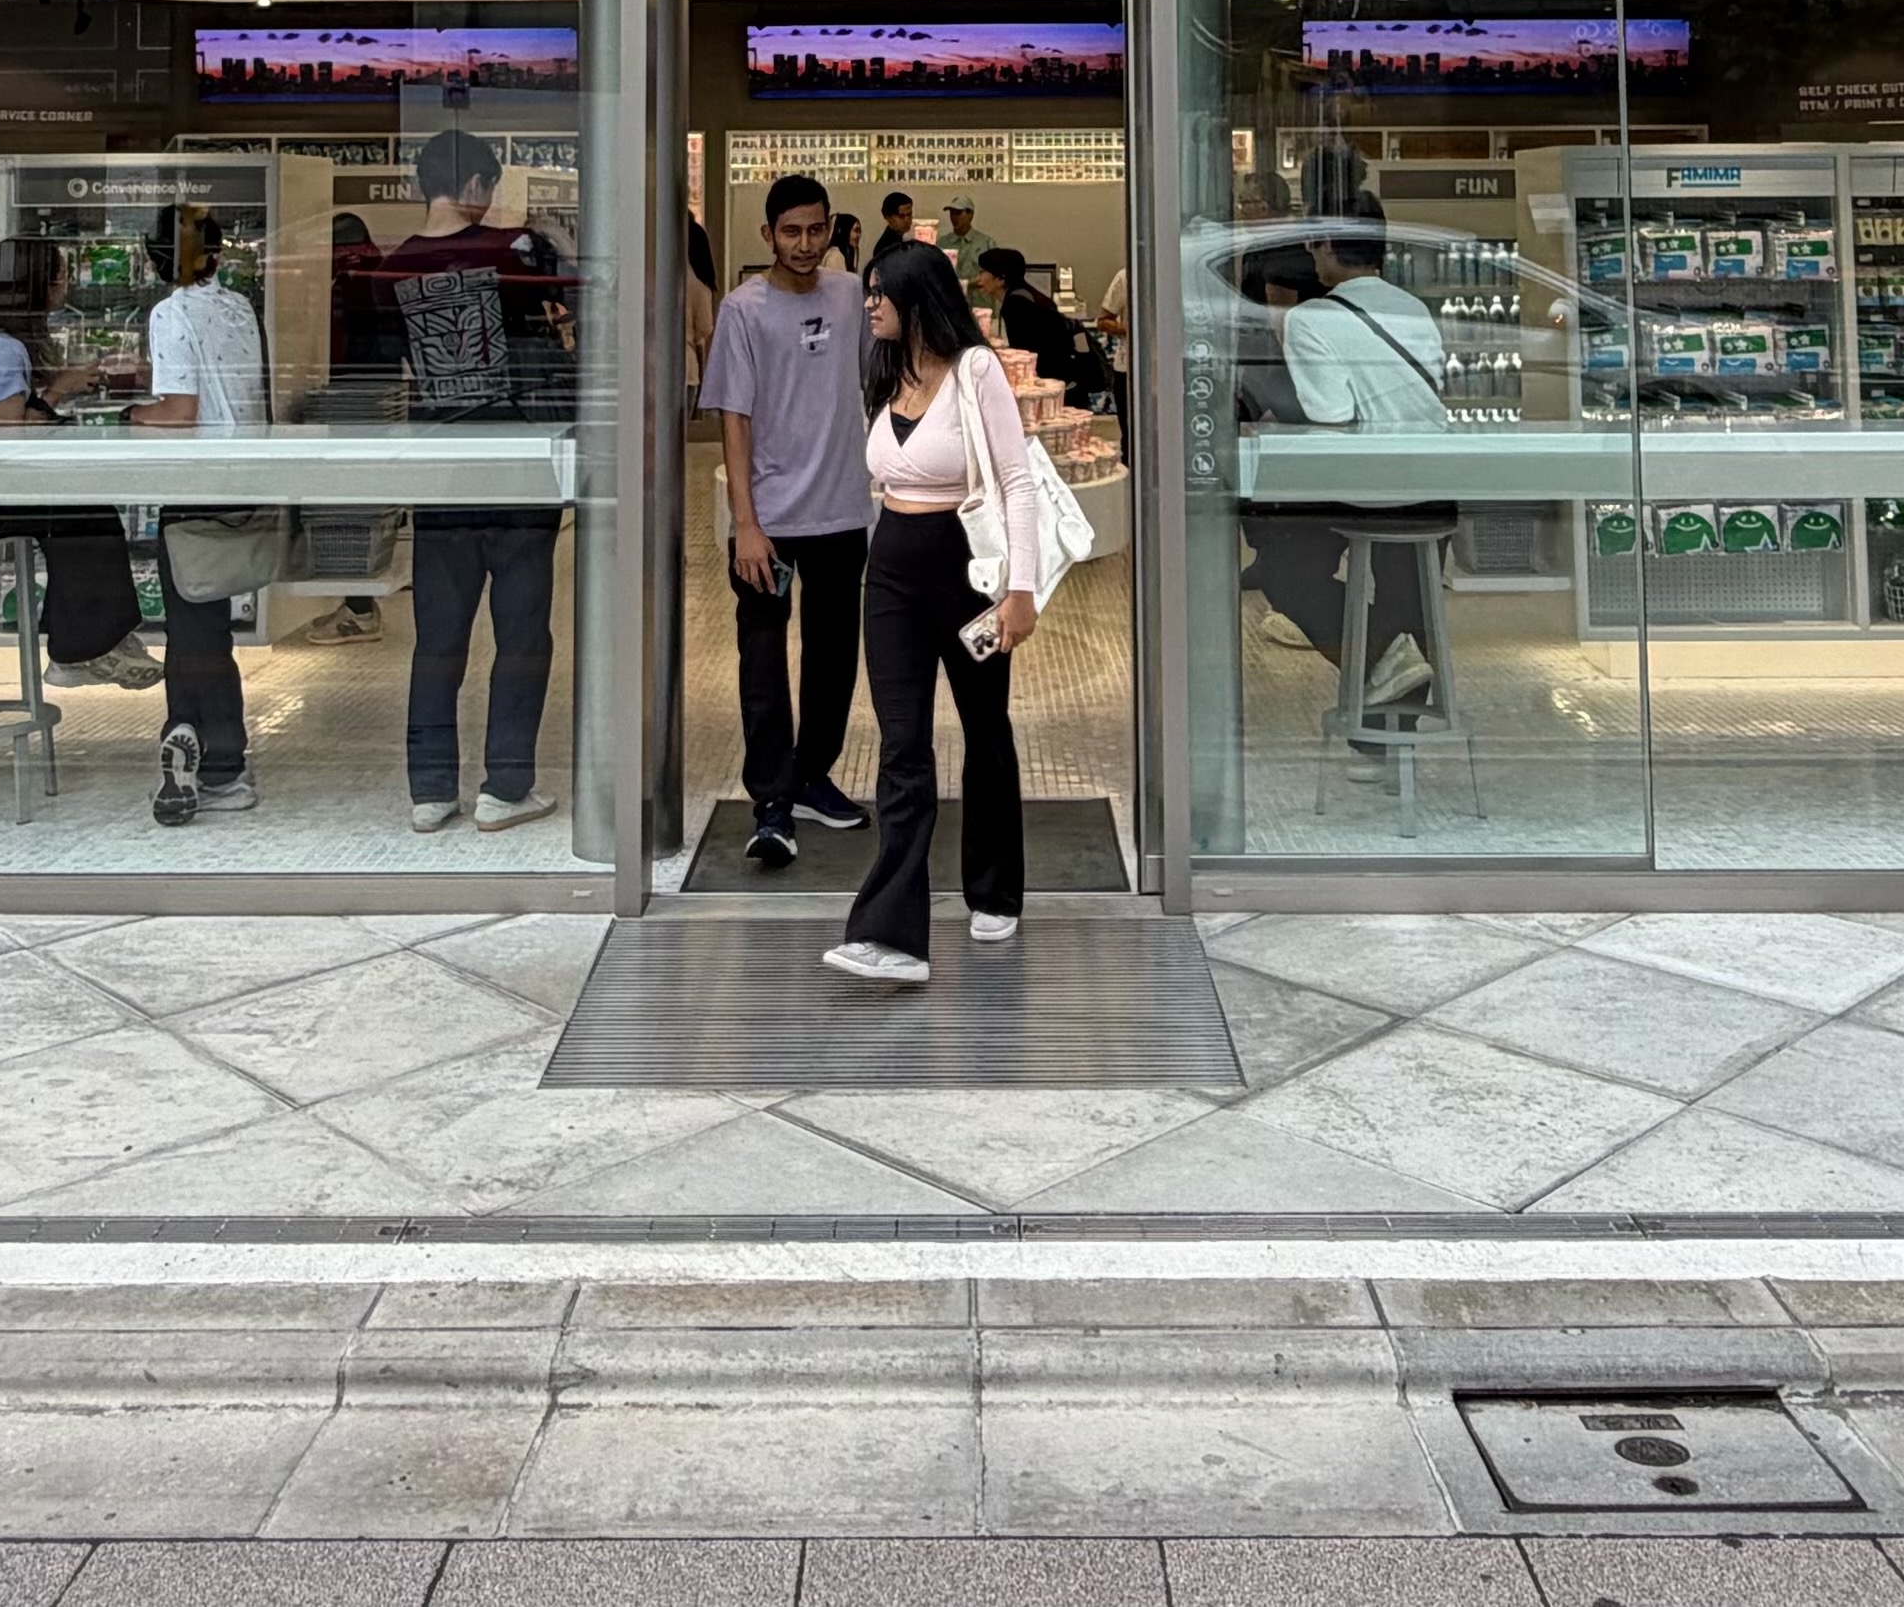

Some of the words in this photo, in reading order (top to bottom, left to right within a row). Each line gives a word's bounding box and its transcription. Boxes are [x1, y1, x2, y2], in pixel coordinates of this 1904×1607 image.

[1798, 85, 1832, 97] SELF
[1836, 83, 1878, 96] CHECK
[39, 111, 94, 122] CORNER
[1665, 167, 1741, 188] FAMIMA
[91, 181, 177, 195] Convenience
[178, 181, 213, 195] Wear
[369, 183, 412, 201] FUN
[1455, 177, 1498, 195] FUN
